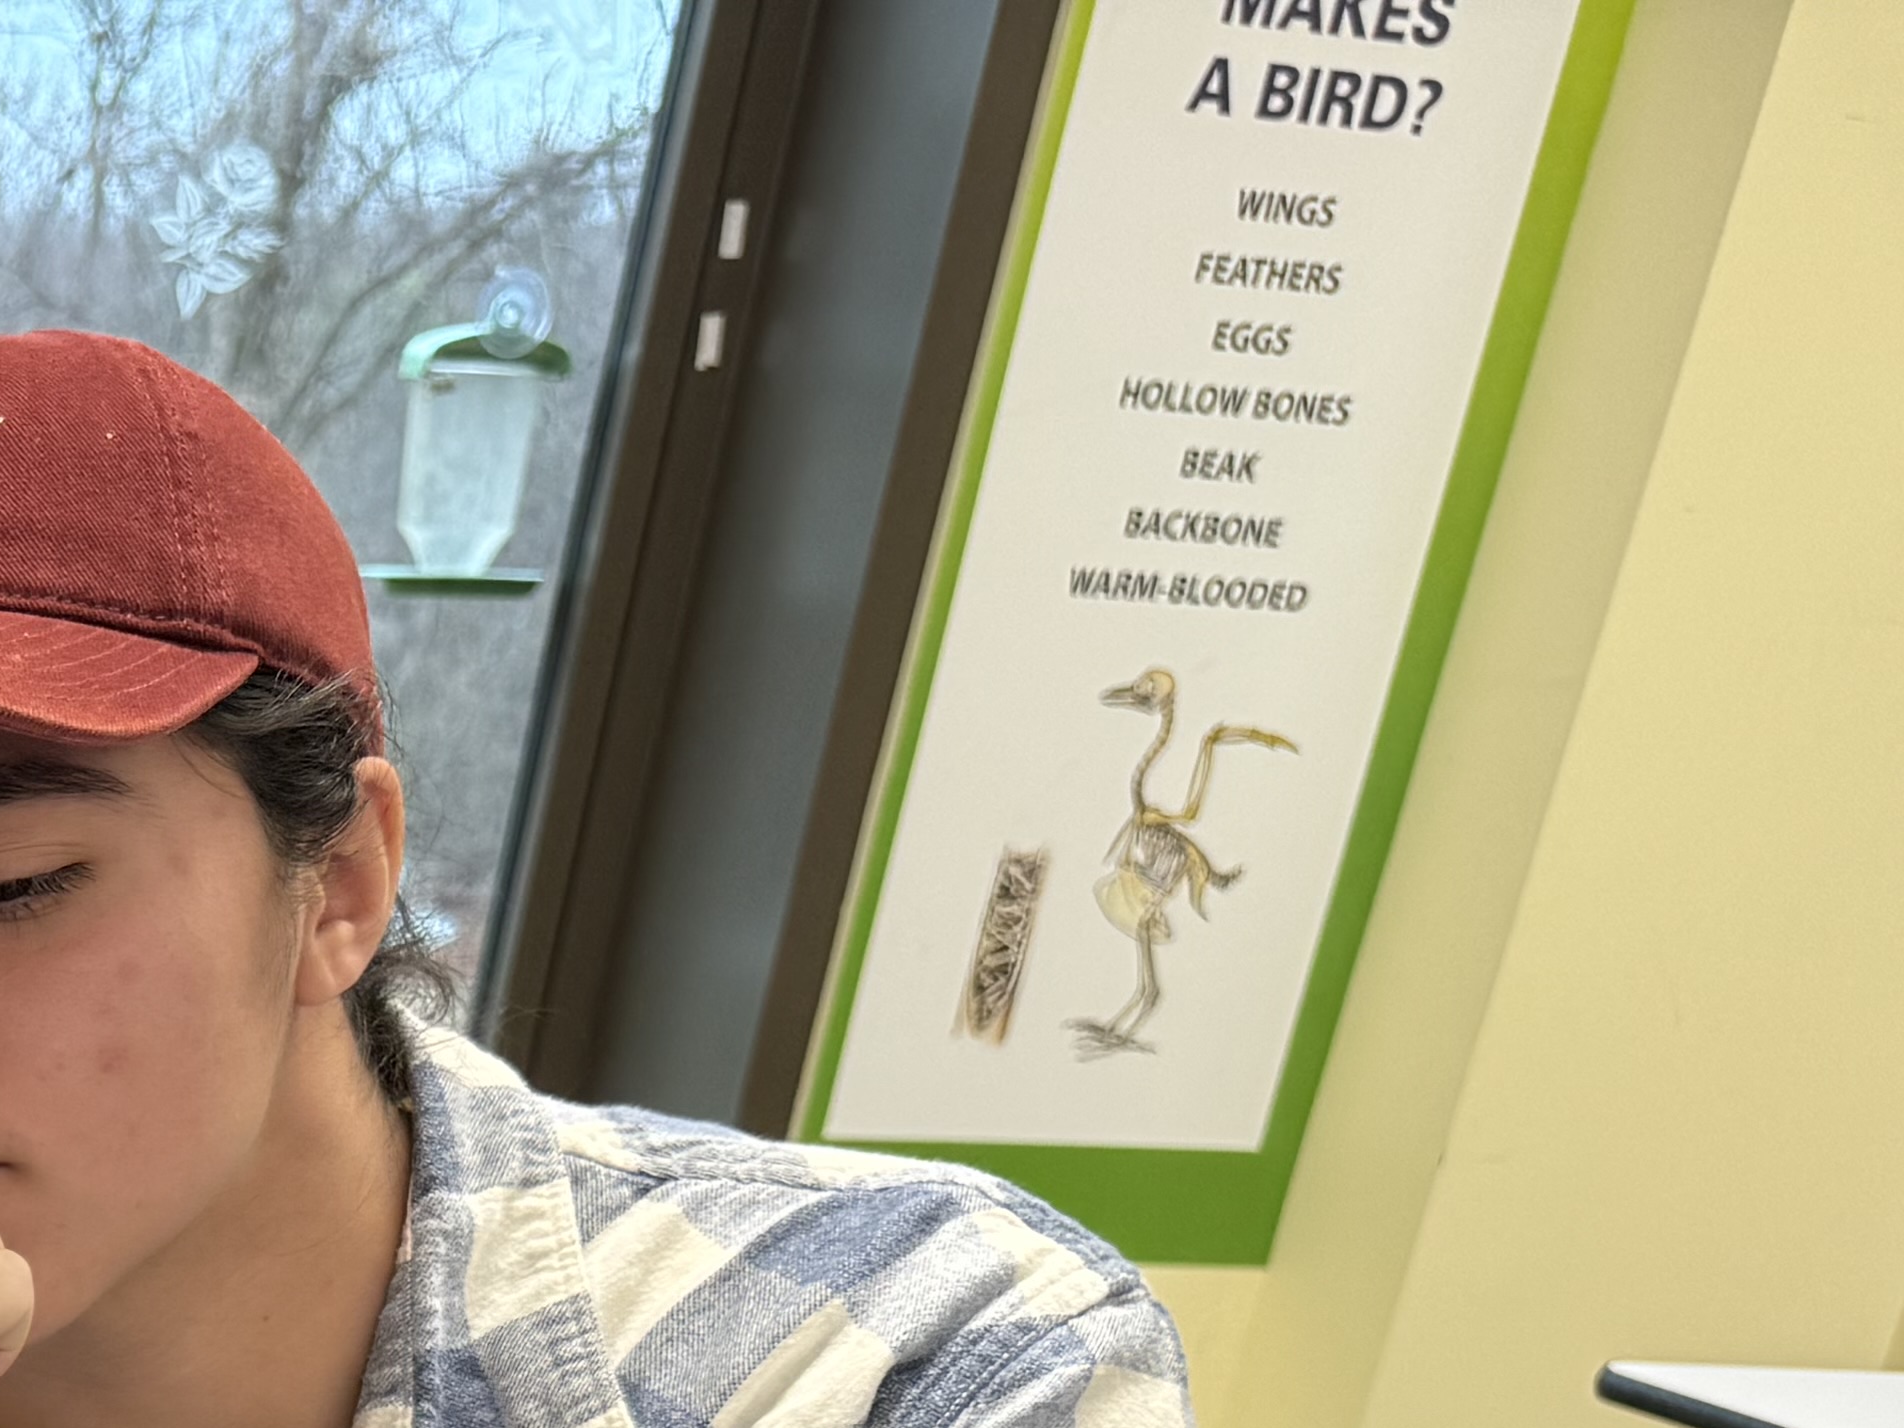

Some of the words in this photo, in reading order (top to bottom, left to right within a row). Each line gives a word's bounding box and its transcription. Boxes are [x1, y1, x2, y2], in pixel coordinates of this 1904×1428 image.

[1184, 55, 1233, 118] A
[1253, 62, 1444, 137] BIRD?
[1237, 187, 1339, 229] WINGS
[1193, 251, 1345, 296] FEATHERS
[1210, 318, 1296, 357] EGGS
[1118, 375, 1251, 418] HOLLOW
[1251, 387, 1354, 427] BONES
[1178, 445, 1263, 484] BEAK
[1123, 506, 1285, 549] BACKBONE
[1069, 564, 1311, 613] WARM-BLOODED
